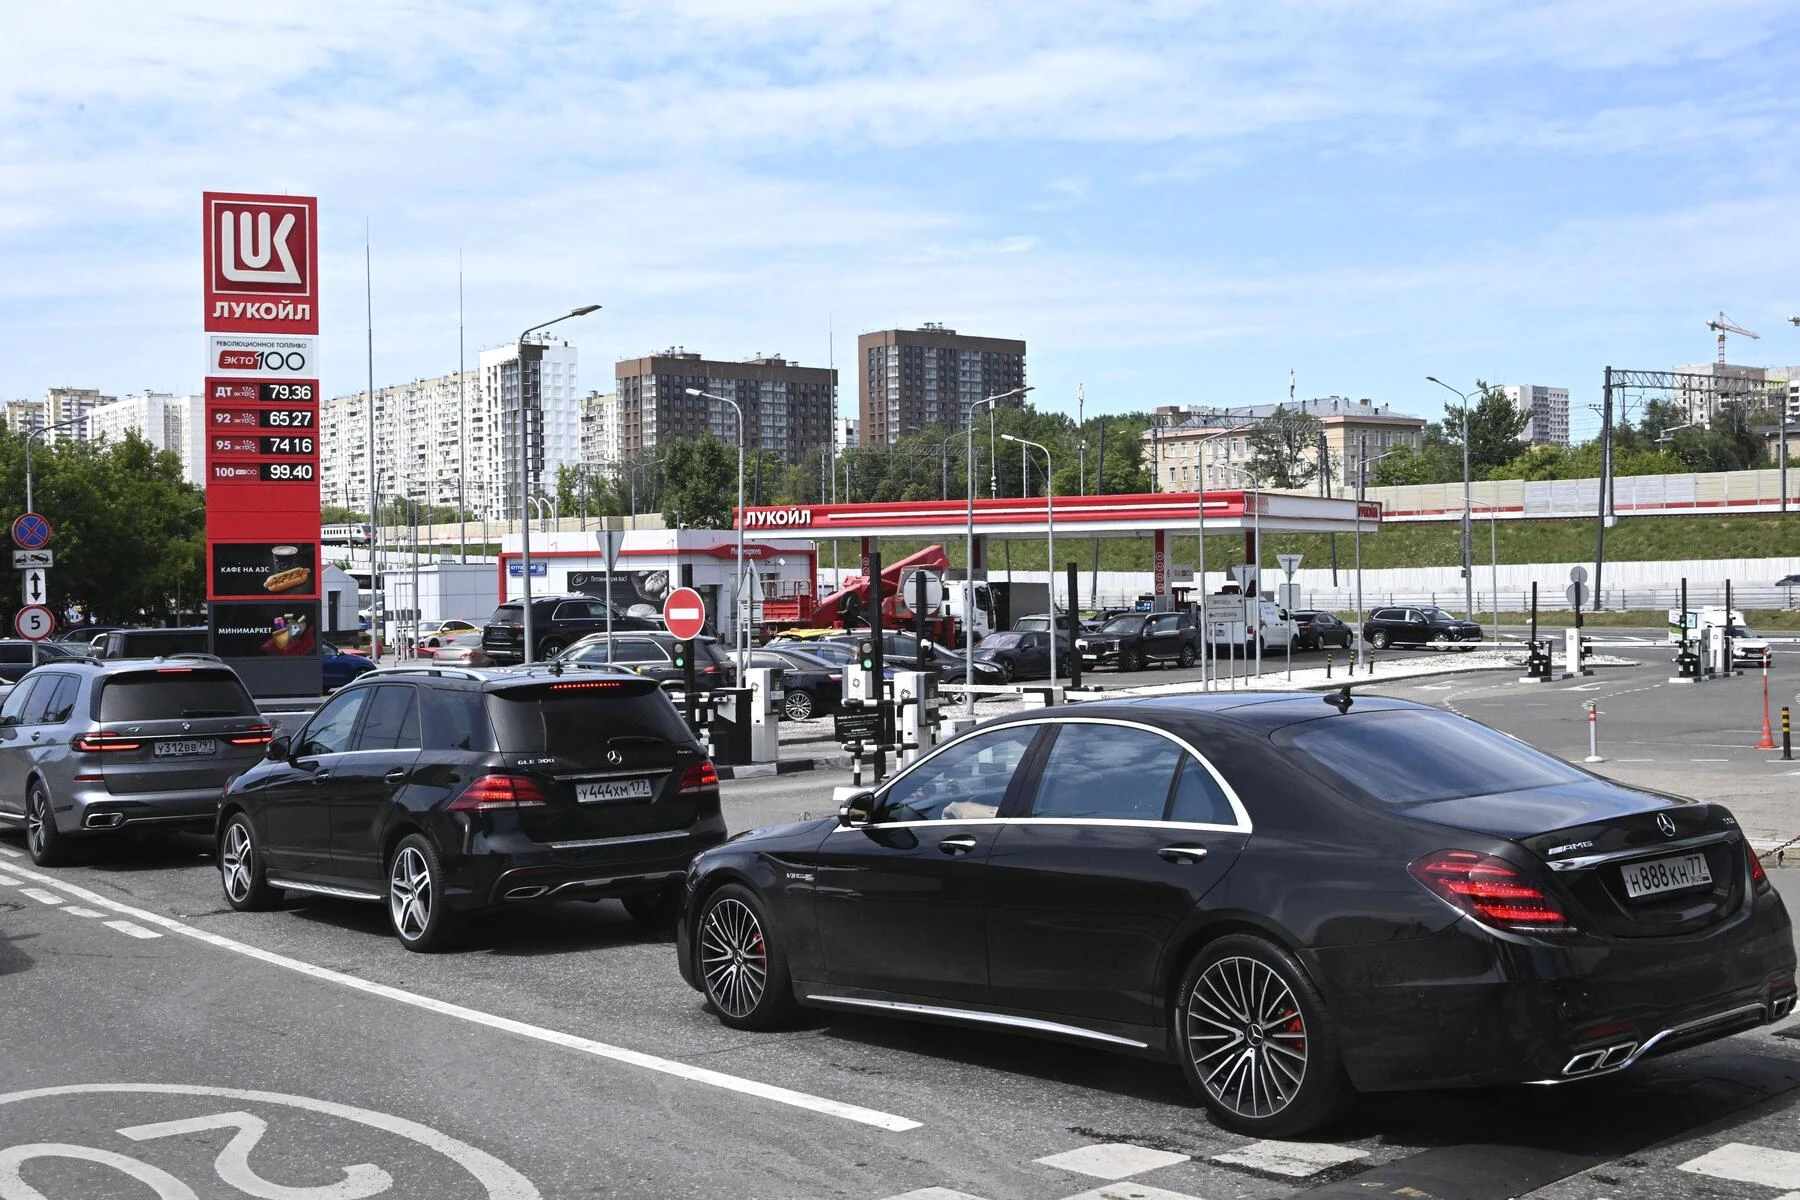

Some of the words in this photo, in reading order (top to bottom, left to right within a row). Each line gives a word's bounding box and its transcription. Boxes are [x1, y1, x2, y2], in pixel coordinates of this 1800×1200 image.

[213, 300, 310, 320] ЛУКОЙЛ
[216, 341, 275, 349] РЕВОЛЮЦИОННОЕ
[224, 356, 254, 365] ЭКТО
[216, 387, 233, 398] ДТ
[270, 385, 311, 399] 79.36
[216, 414, 231, 423] 92
[216, 441, 231, 450] 95
[215, 468, 234, 477] 100
[270, 465, 312, 479] 99.40
[745, 508, 811, 526] ЛУКОЙЛ
[31, 616, 40, 630] 5
[1687, 857, 1701, 874] 77
